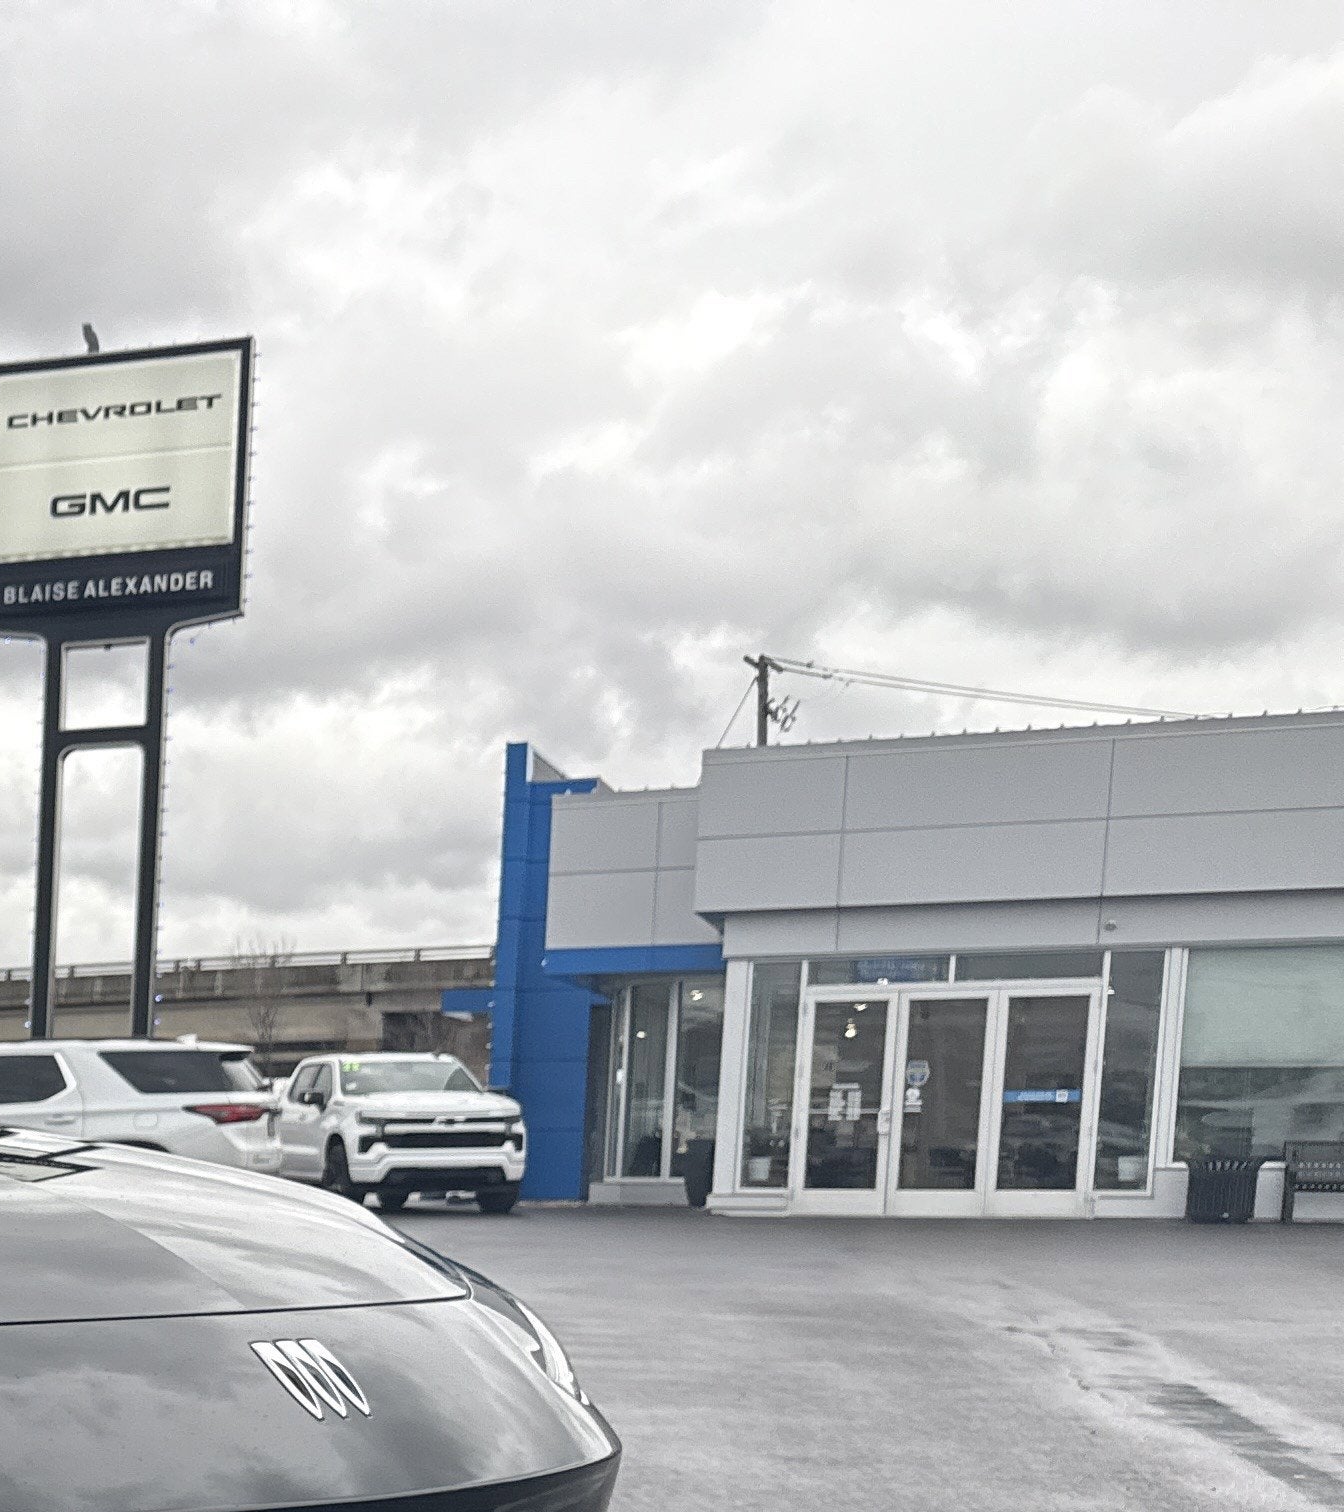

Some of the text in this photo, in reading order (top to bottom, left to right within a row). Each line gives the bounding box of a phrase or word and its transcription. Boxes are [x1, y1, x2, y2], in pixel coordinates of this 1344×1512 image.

[7, 393, 222, 430] CHEVROLET
[50, 486, 171, 518] GMC
[3, 569, 214, 605] BLAISE ALEXANDER
